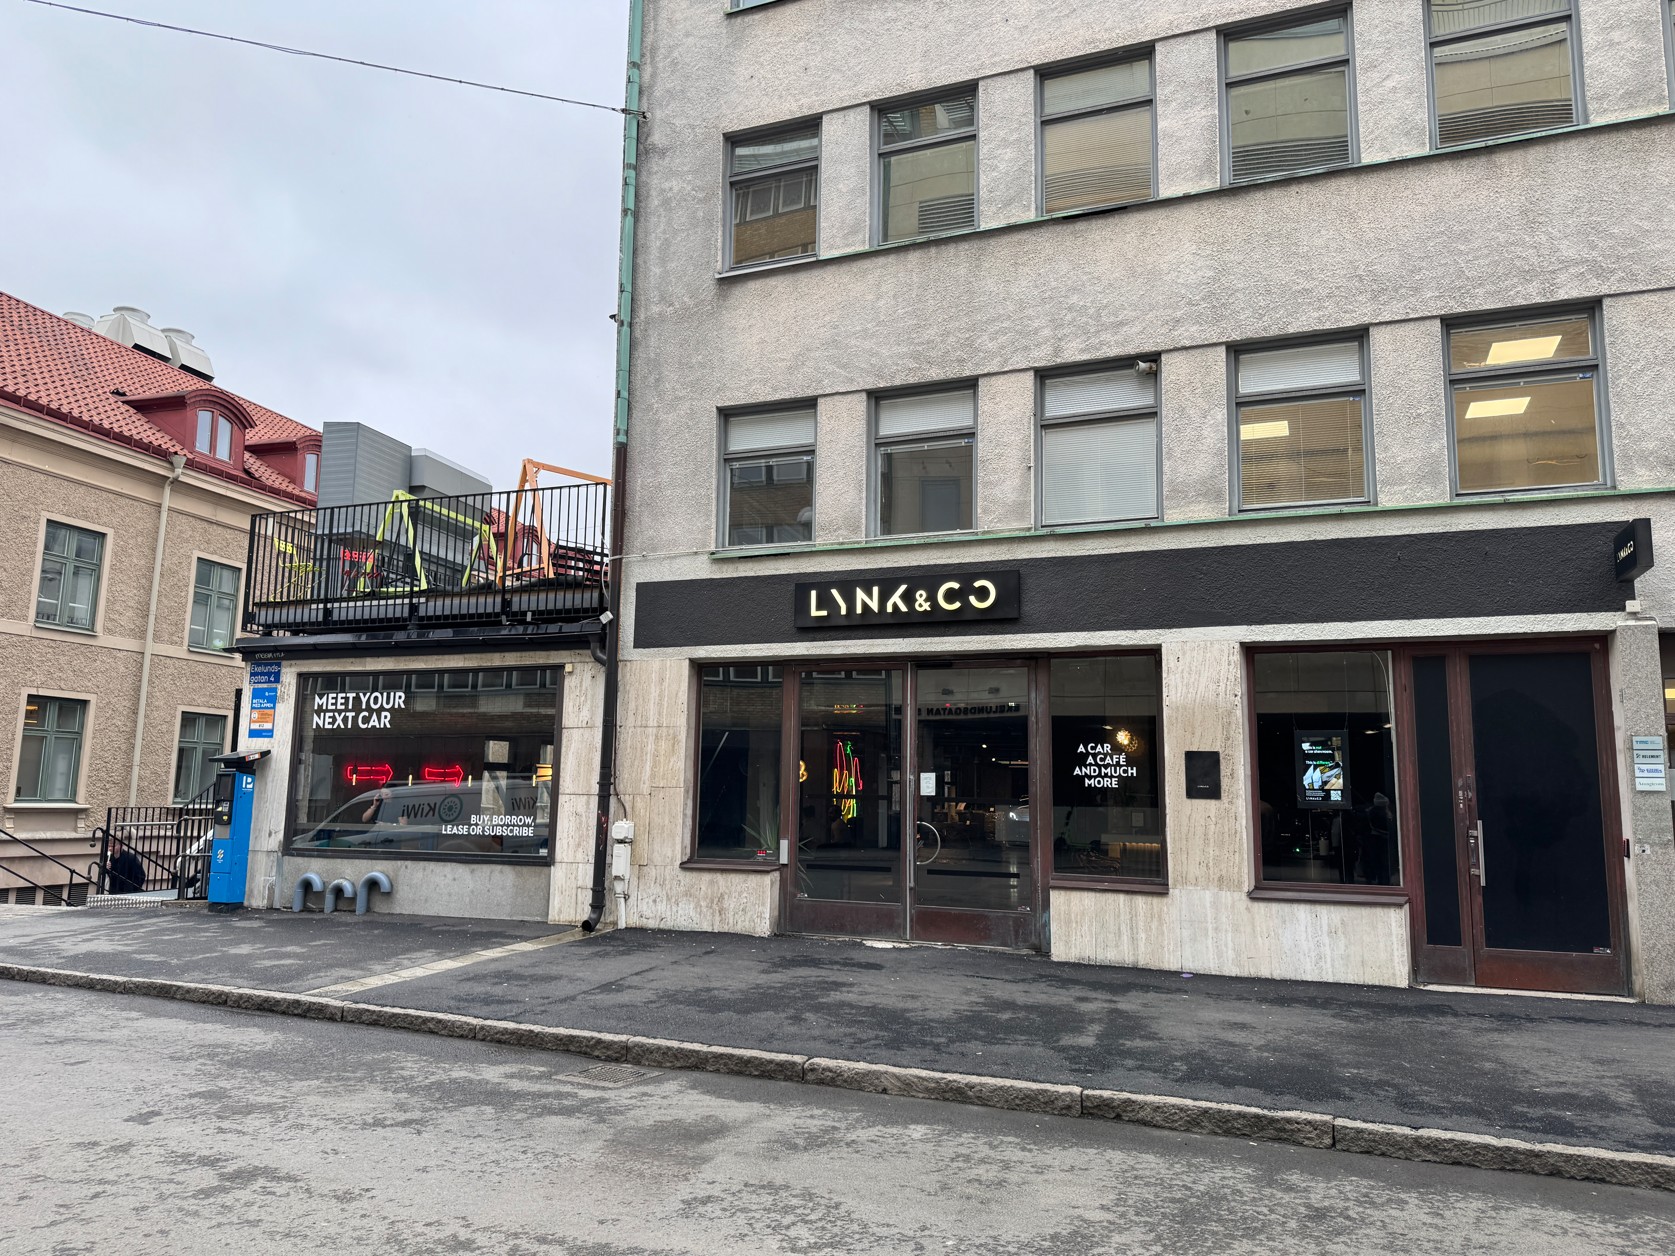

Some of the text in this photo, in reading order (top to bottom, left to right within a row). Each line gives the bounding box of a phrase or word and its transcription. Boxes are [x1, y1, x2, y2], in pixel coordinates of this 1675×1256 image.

[251, 664, 281, 673] Ekelunds-
[250, 674, 275, 684] gatan 4
[314, 691, 405, 710] MEET YOUR
[312, 711, 391, 729] NEXT CAR
[1077, 743, 1111, 753] A CAR
[1086, 752, 1127, 765] A CAFÉ
[1073, 766, 1137, 777] AND MUCH
[1085, 777, 1119, 788] MORE
[471, 814, 535, 827] BUY, BORROW,
[442, 825, 534, 837] LEASE OR SUBSCRIBE
